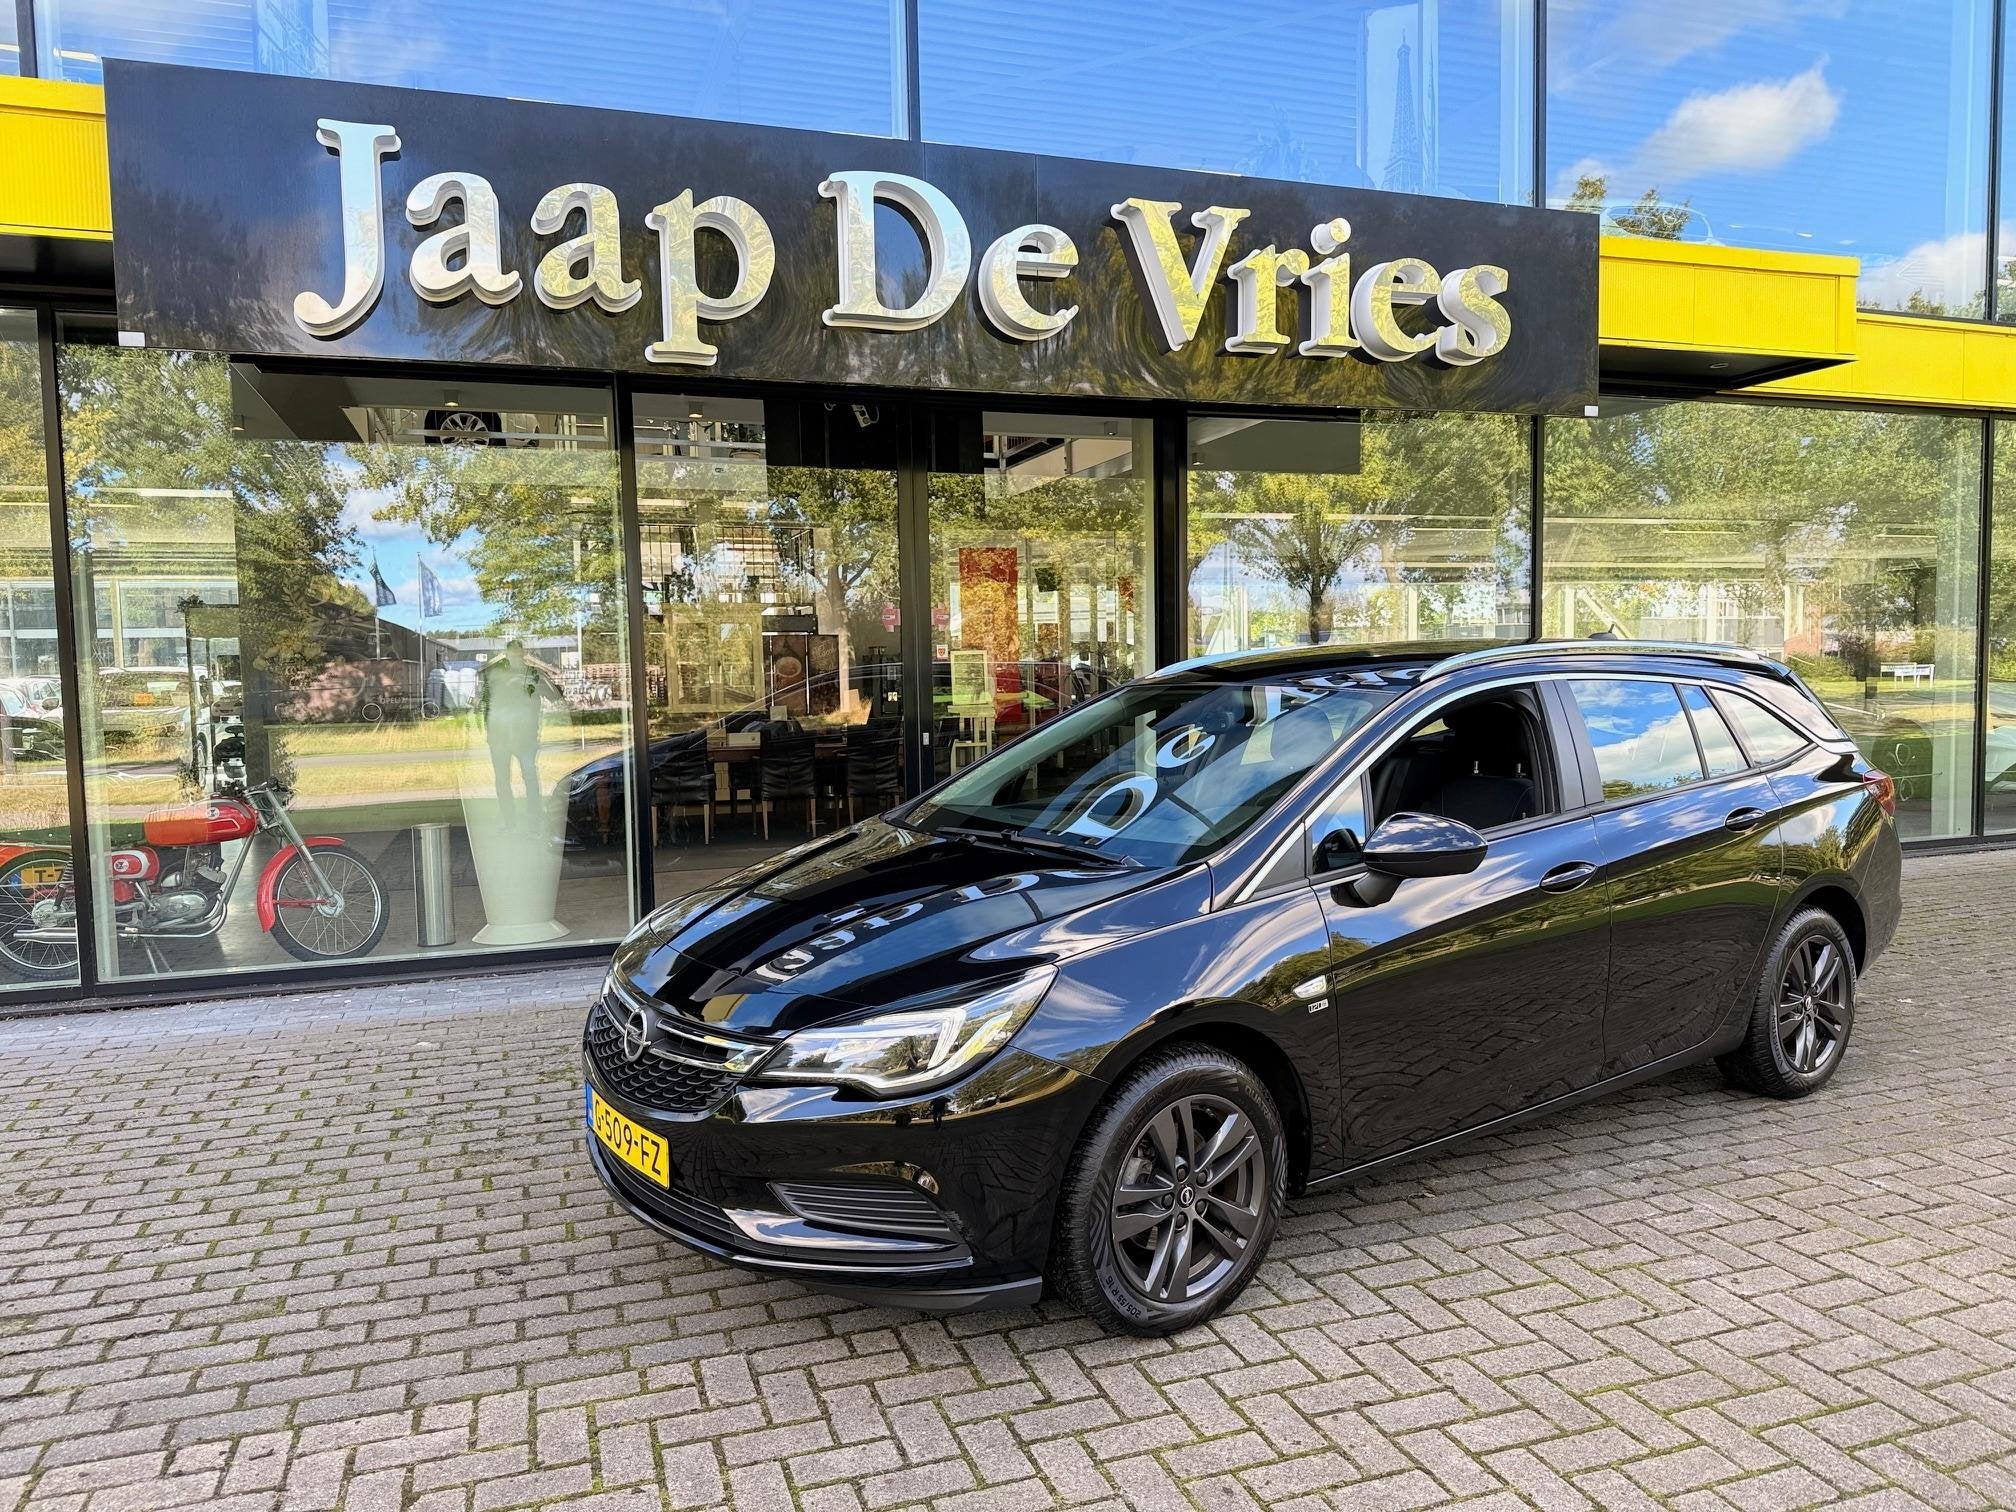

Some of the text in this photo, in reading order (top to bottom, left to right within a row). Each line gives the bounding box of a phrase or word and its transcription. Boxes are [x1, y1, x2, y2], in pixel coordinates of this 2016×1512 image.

[294, 118, 1512, 366] Jaap De Vries
[595, 1099, 661, 1177] G-509-FZ
[1106, 1275, 1142, 1319] 205/55 R 16
